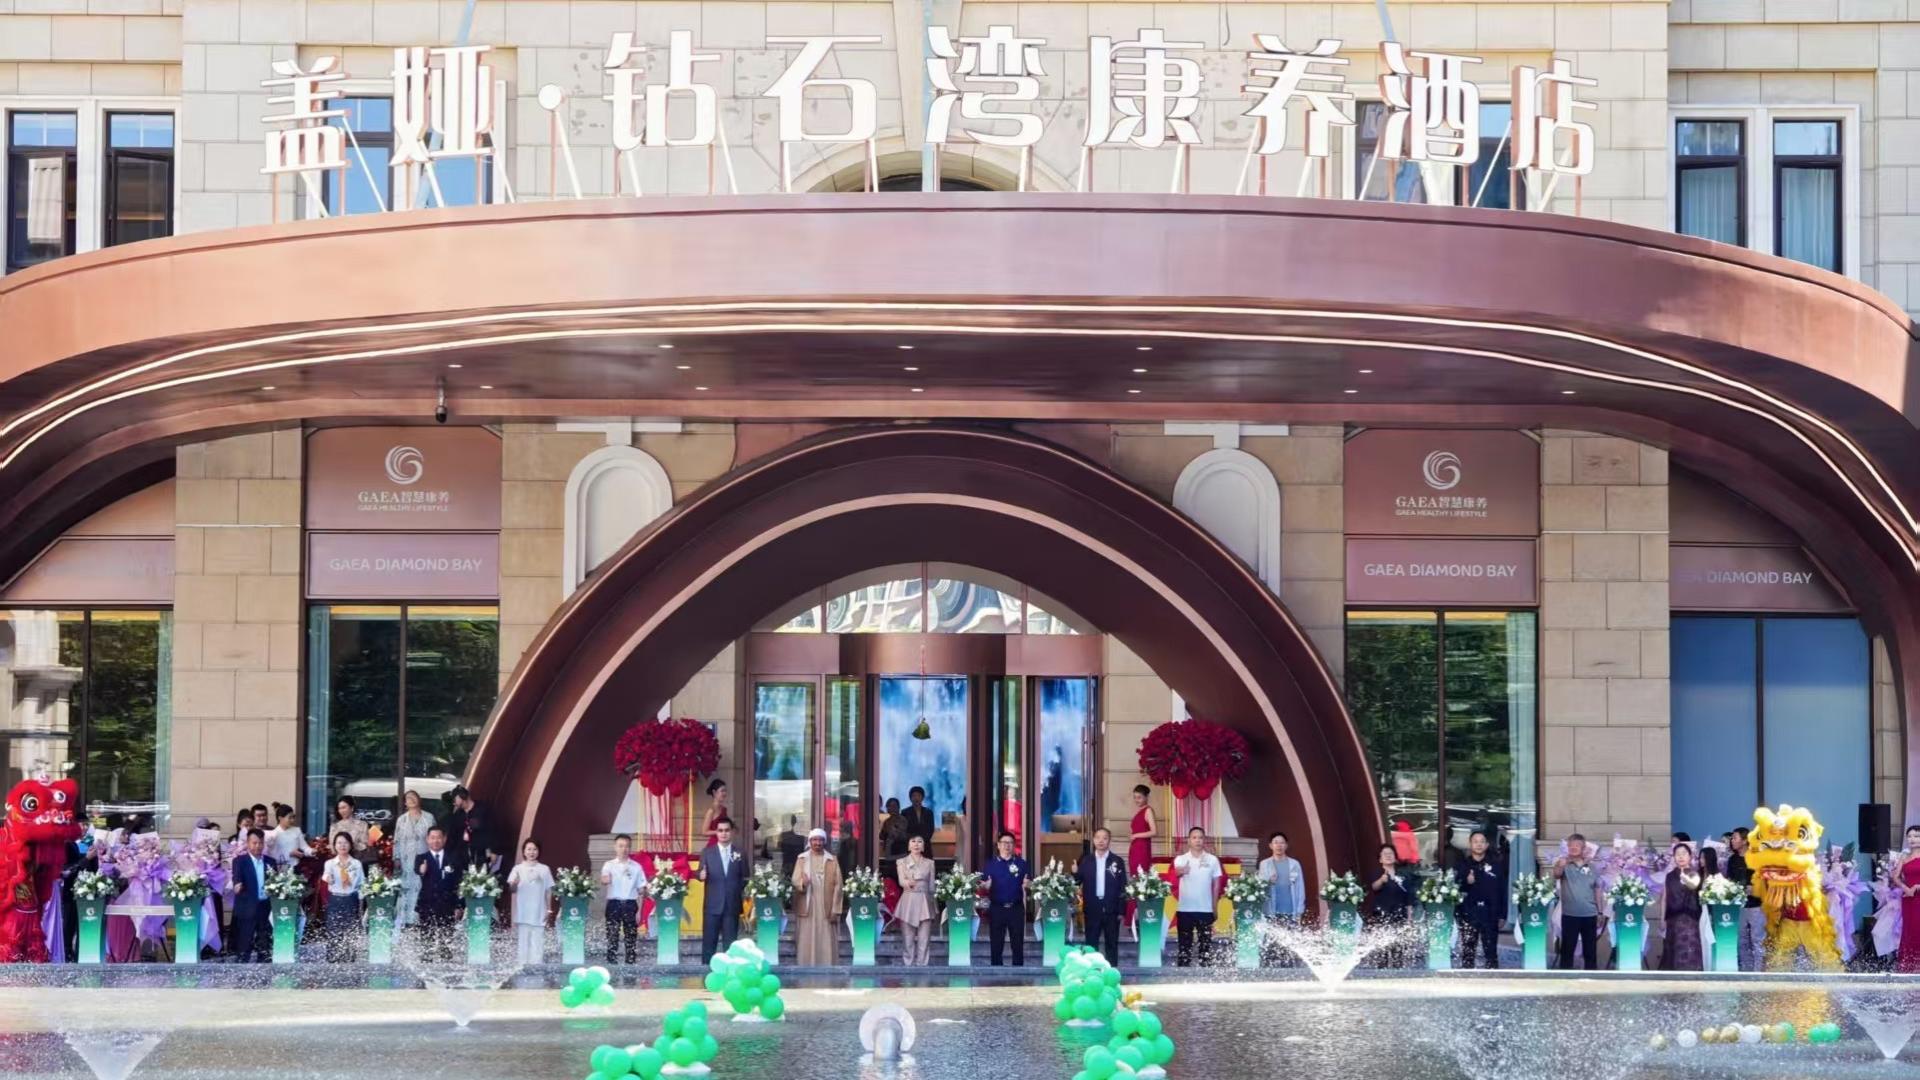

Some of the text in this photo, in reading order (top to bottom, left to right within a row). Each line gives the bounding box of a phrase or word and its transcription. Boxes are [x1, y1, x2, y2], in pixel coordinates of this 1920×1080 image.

[330, 558, 482, 571] GAEA DIAMOND BAY
[1364, 563, 1517, 577] GAEA DIAMOND BAY
[1706, 571, 1779, 584] DIAMOND
[1783, 572, 1813, 584] BAY
